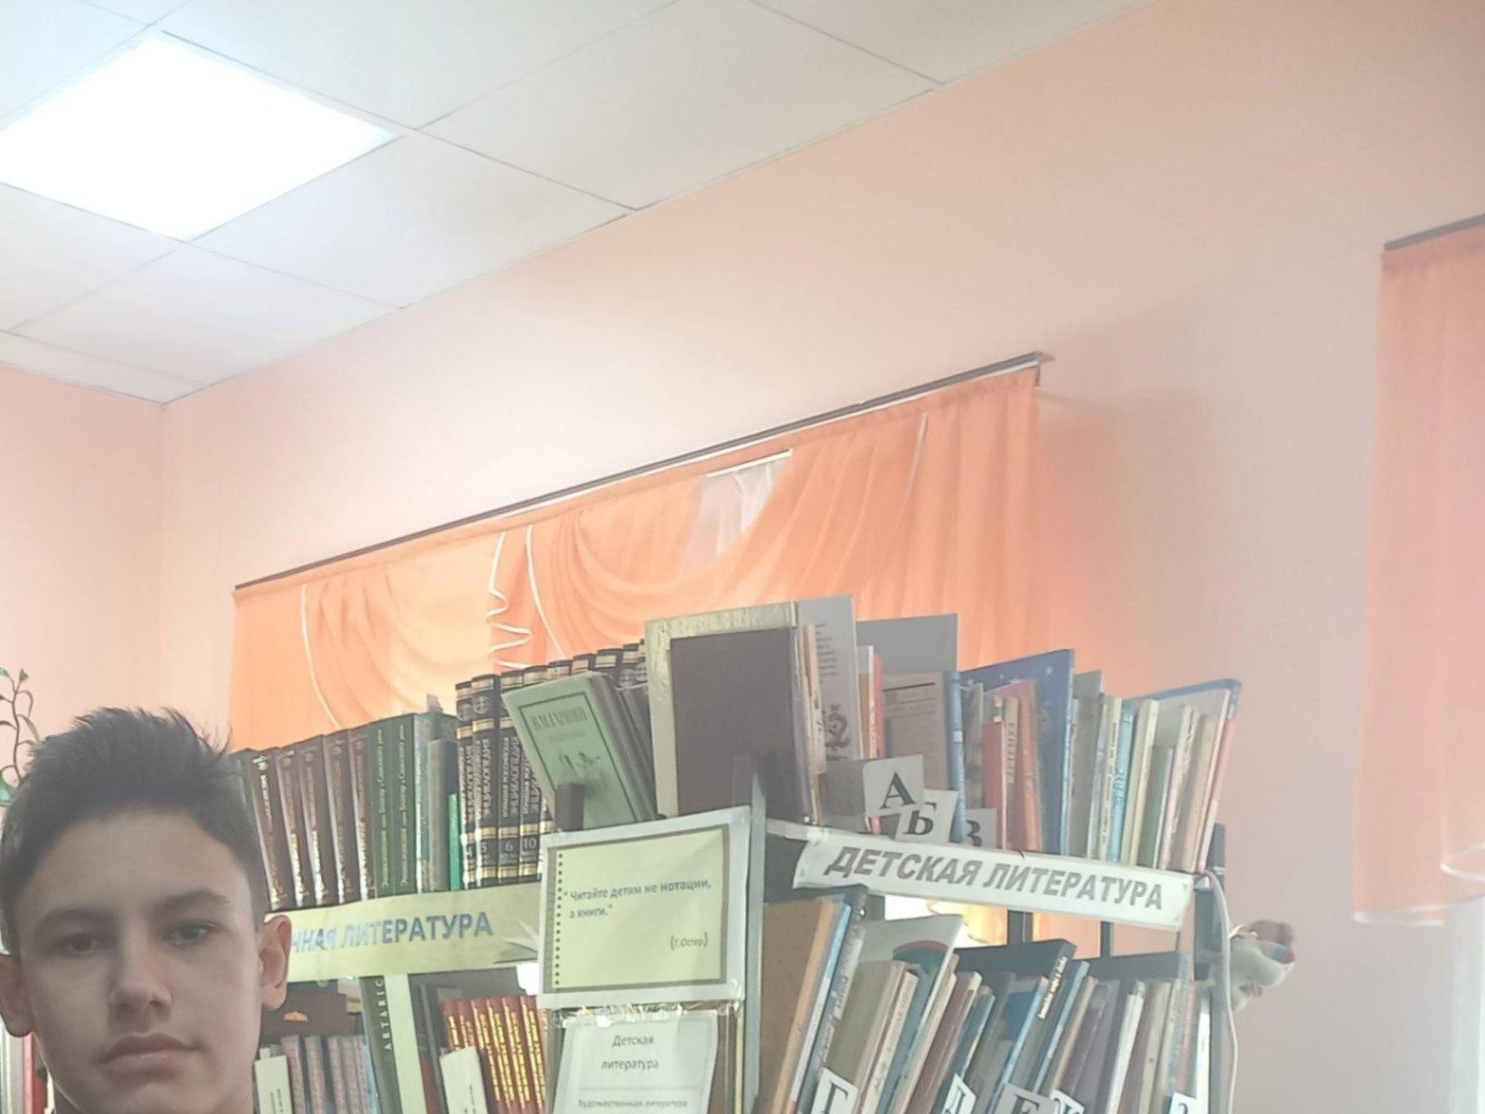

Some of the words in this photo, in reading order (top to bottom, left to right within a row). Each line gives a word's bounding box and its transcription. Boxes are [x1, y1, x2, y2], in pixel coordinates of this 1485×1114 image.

[880, 770, 918, 810] А
[905, 800, 938, 836] Б
[521, 836, 538, 851] 10
[569, 887, 609, 902] Читайте
[610, 884, 643, 899] детям
[644, 884, 659, 895] не
[660, 878, 713, 893] нотации,
[823, 846, 984, 887] ДЕТСКАЯ
[983, 862, 1164, 911] ЛИТЕРАТУРА
[339, 910, 495, 950] ЛИТЕРАТУРА
[611, 1034, 655, 1048] Детская
[600, 1058, 660, 1073] литература
